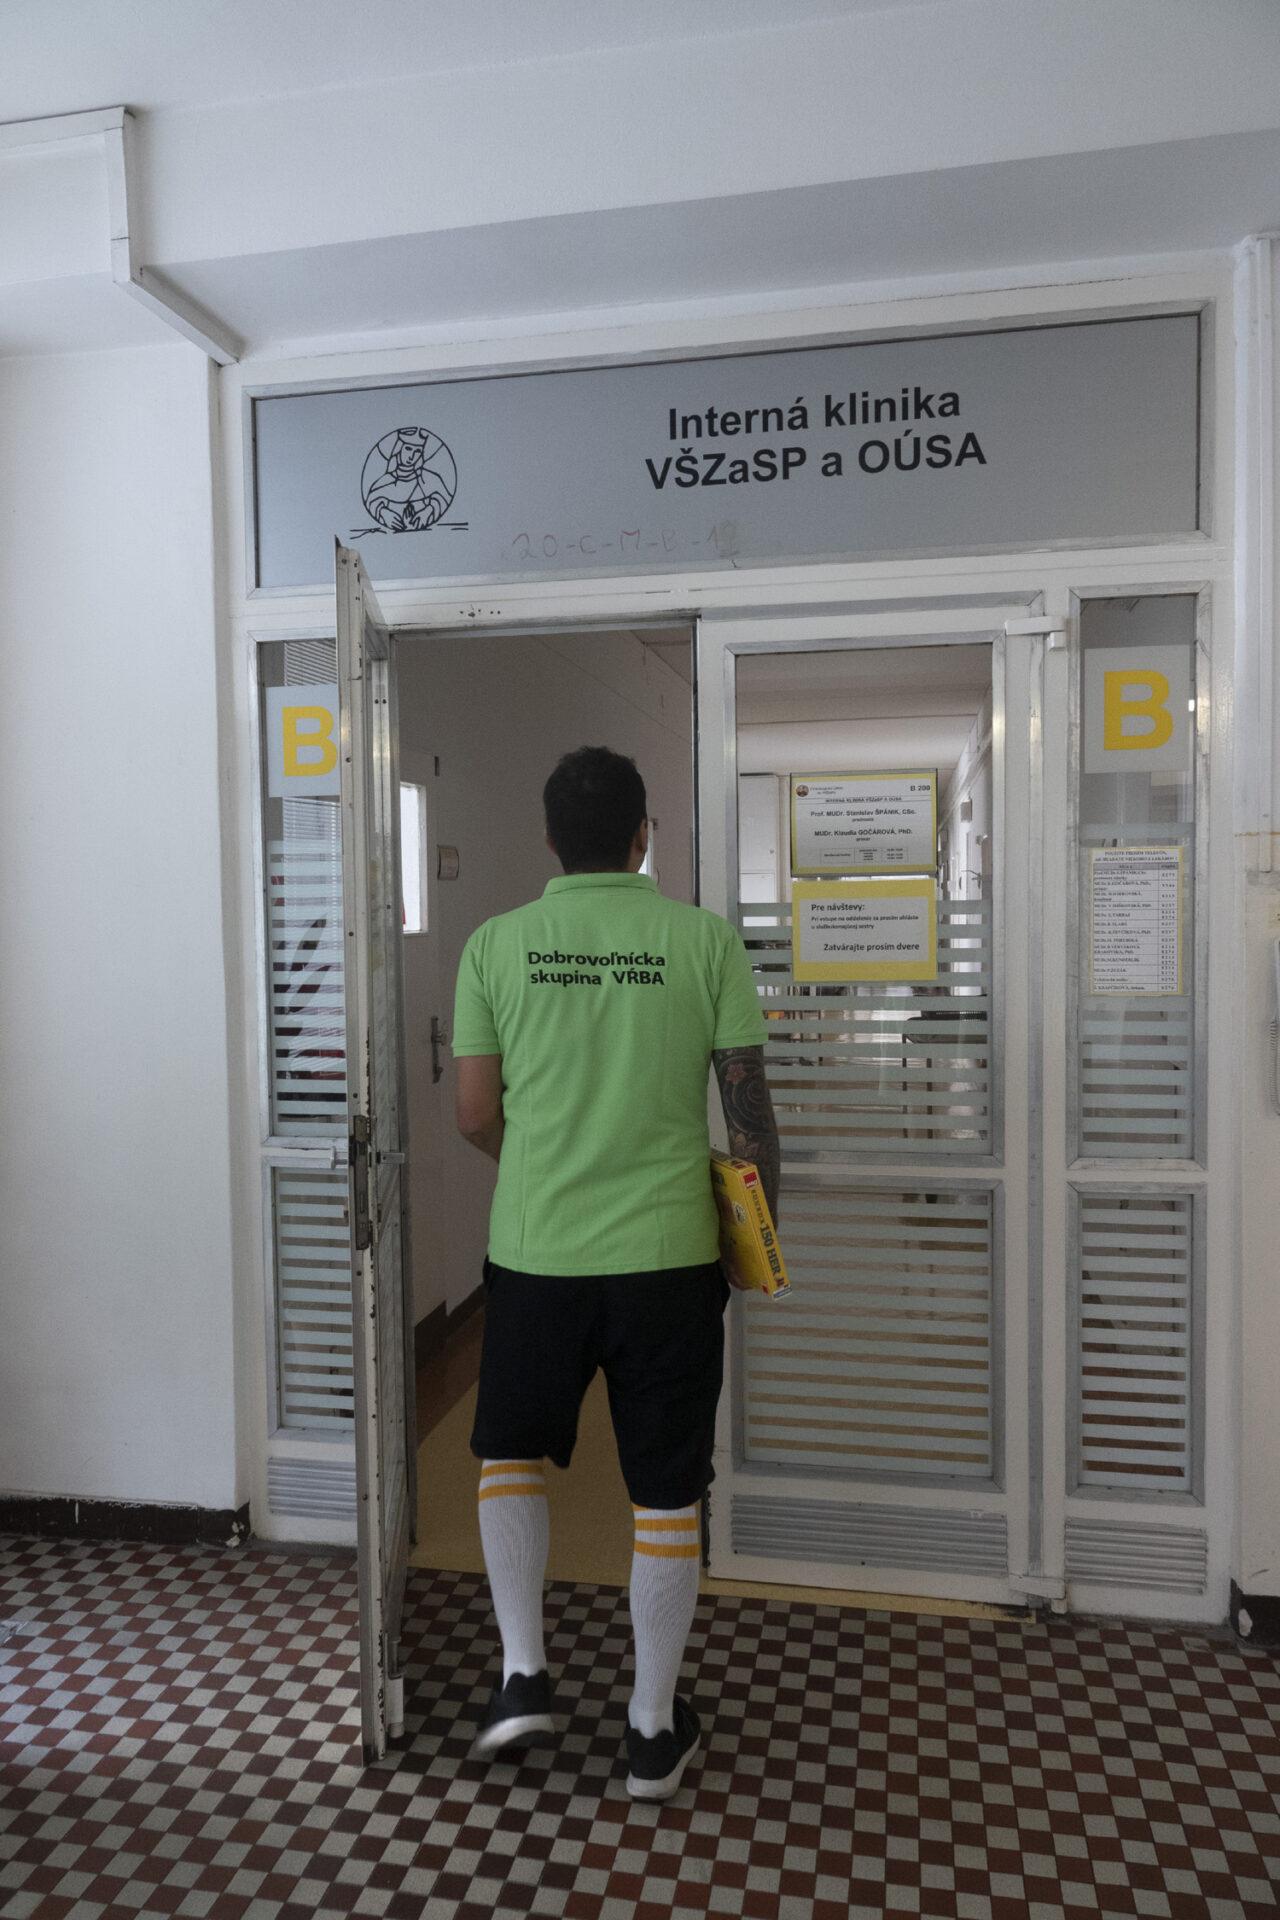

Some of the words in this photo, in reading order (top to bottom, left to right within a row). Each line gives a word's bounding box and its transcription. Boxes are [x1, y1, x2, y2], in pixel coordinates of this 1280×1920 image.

[669, 396, 809, 441] Interná
[824, 386, 961, 427] klinika
[645, 446, 807, 491] VŠZaSP
[821, 452, 843, 477] a
[858, 429, 987, 474] OÚSA
[1103, 670, 1174, 751] B
[282, 706, 338, 777] B
[811, 903, 825, 912] Pre
[827, 902, 865, 912] návštevy:
[527, 950, 666, 967] Dobrovoľnícka
[823, 943, 865, 953] Zatvárajte
[866, 943, 895, 952] prosím
[896, 942, 920, 951] dvere
[530, 969, 602, 987] skupina
[612, 968, 665, 986] VŔBA
[760, 1225, 774, 1247] 150
[766, 1247, 782, 1275] HER
